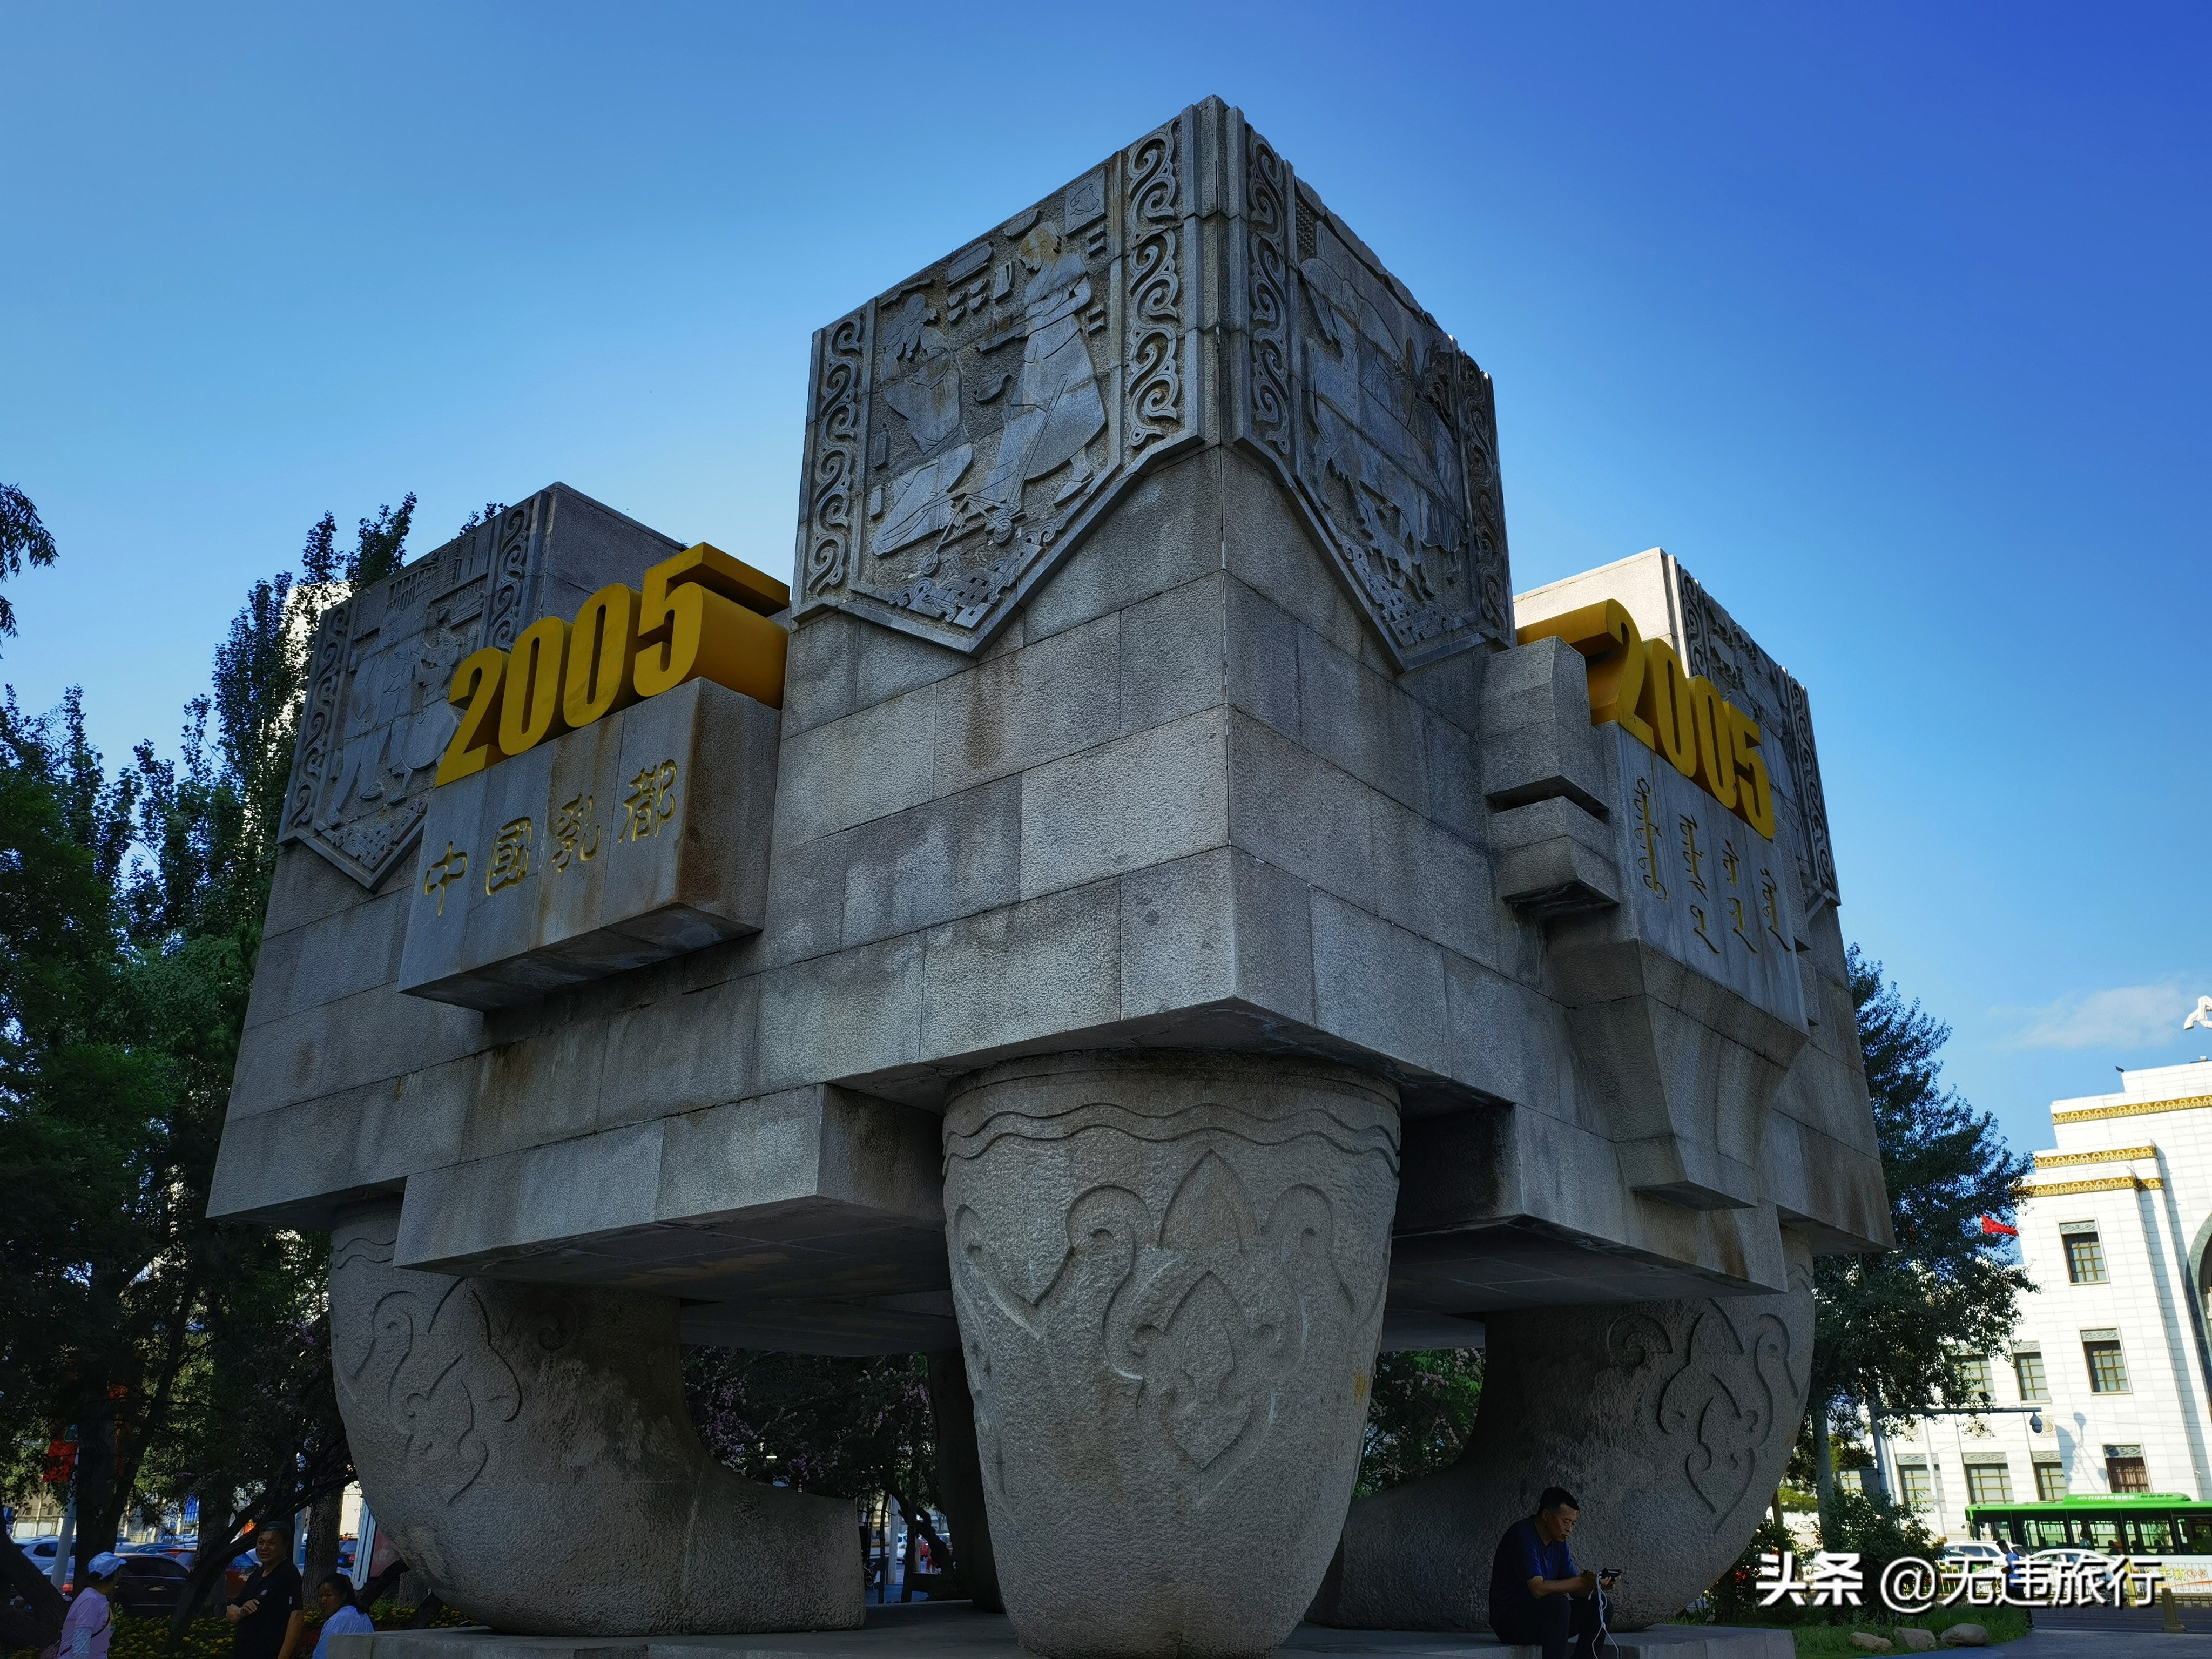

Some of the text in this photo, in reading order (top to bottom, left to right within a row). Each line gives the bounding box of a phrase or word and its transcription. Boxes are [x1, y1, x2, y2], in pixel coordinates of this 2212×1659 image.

[435, 542, 704, 788] 2005
[1609, 598, 1775, 839] 2005
[423, 759, 678, 916] 中國乳都
